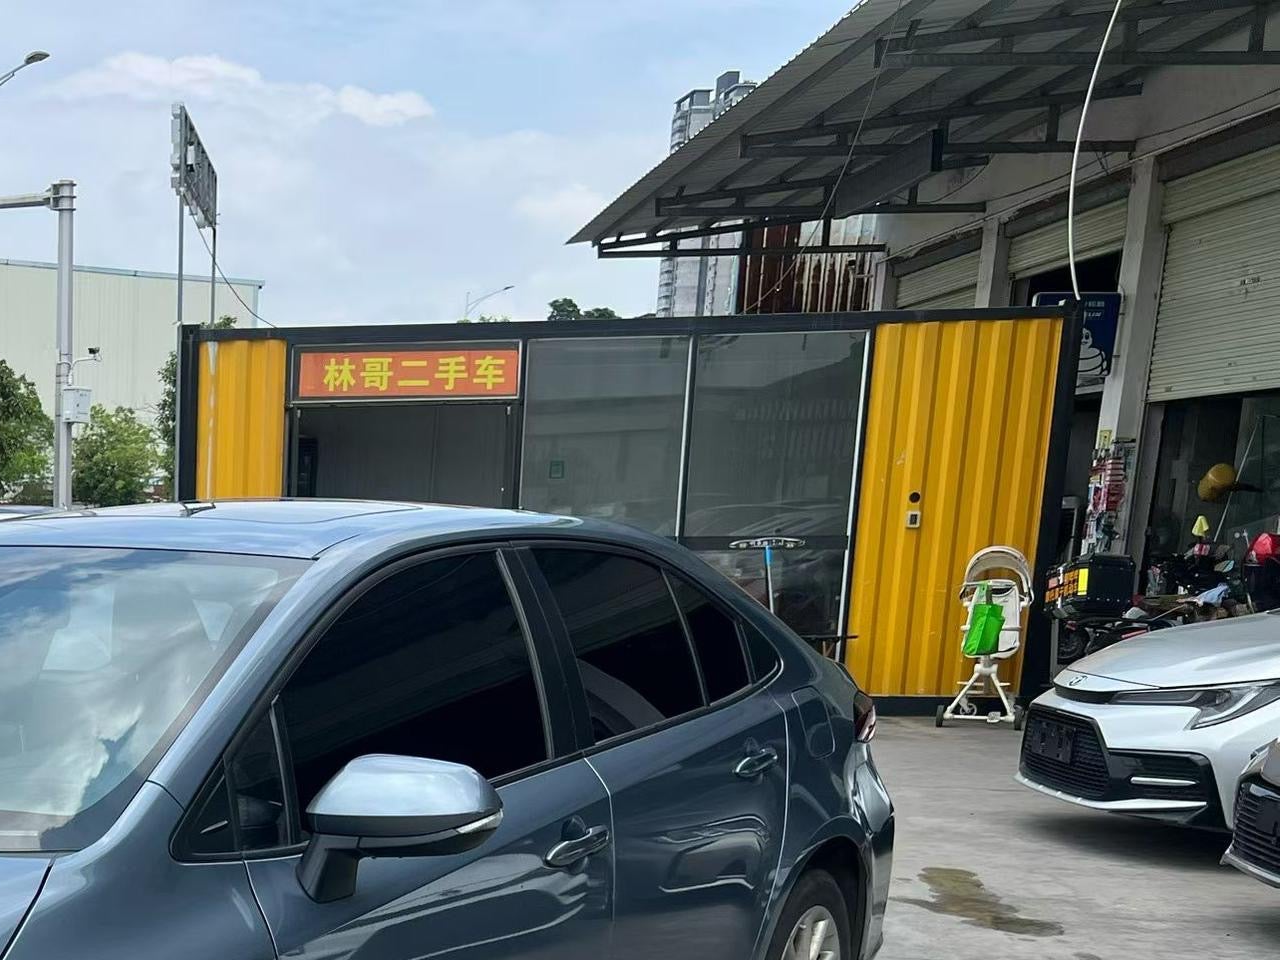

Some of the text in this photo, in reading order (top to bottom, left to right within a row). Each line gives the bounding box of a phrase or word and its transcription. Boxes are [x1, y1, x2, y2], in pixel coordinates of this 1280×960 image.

[323, 356, 505, 391] 林哥二手车
